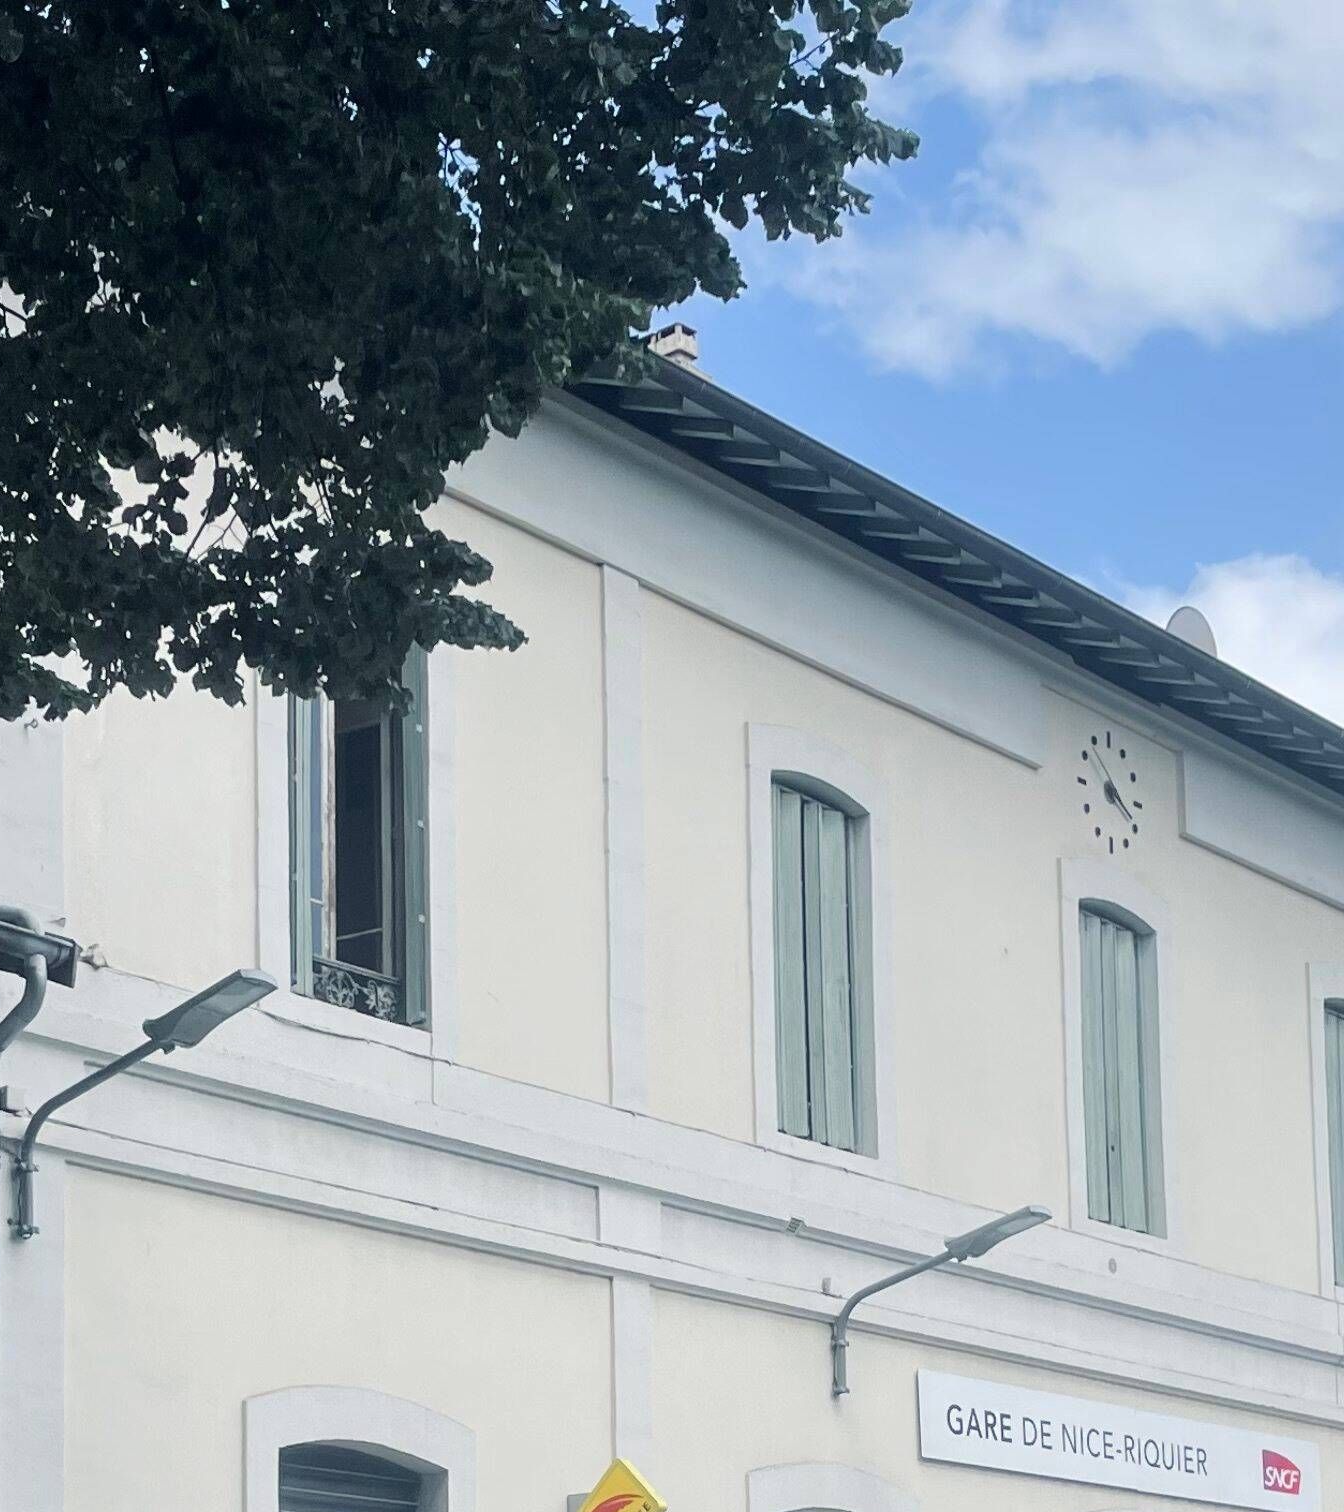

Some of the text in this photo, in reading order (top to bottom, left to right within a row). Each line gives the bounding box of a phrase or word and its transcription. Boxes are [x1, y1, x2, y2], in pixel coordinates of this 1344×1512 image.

[946, 1403, 1209, 1477] GARE DE NICE-RIQUIER
[1264, 1466, 1299, 1489] SNCF
